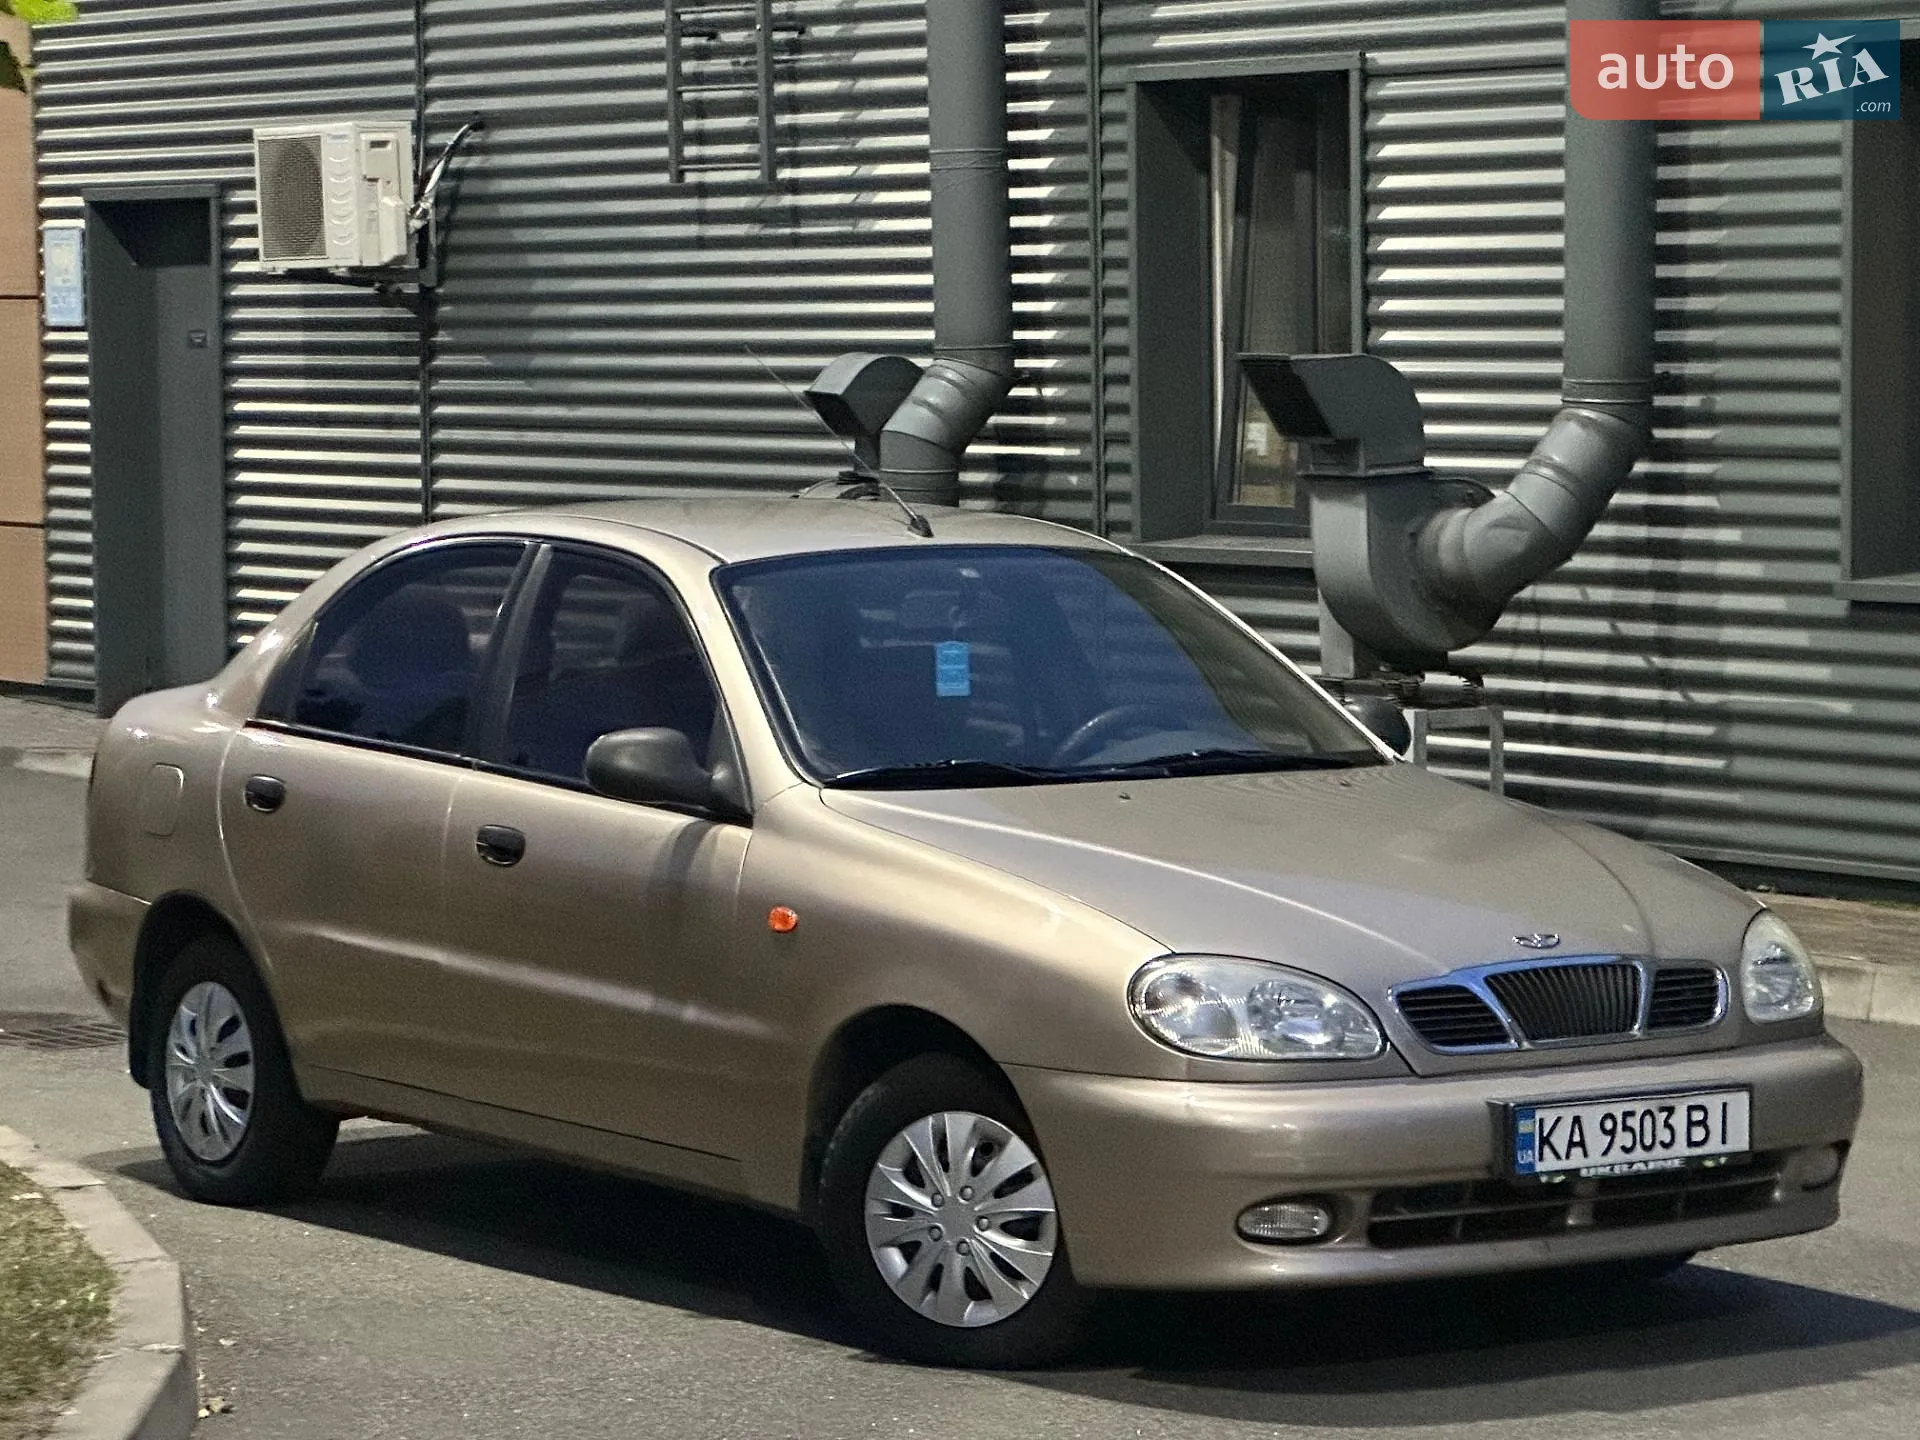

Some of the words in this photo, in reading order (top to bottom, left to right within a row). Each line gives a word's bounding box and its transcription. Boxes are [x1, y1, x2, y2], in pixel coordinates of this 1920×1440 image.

[1538, 1115, 1589, 1162] KA
[1599, 1106, 1676, 1157] 9503
[1686, 1101, 1728, 1148] BI
[1517, 1150, 1534, 1164] UA
